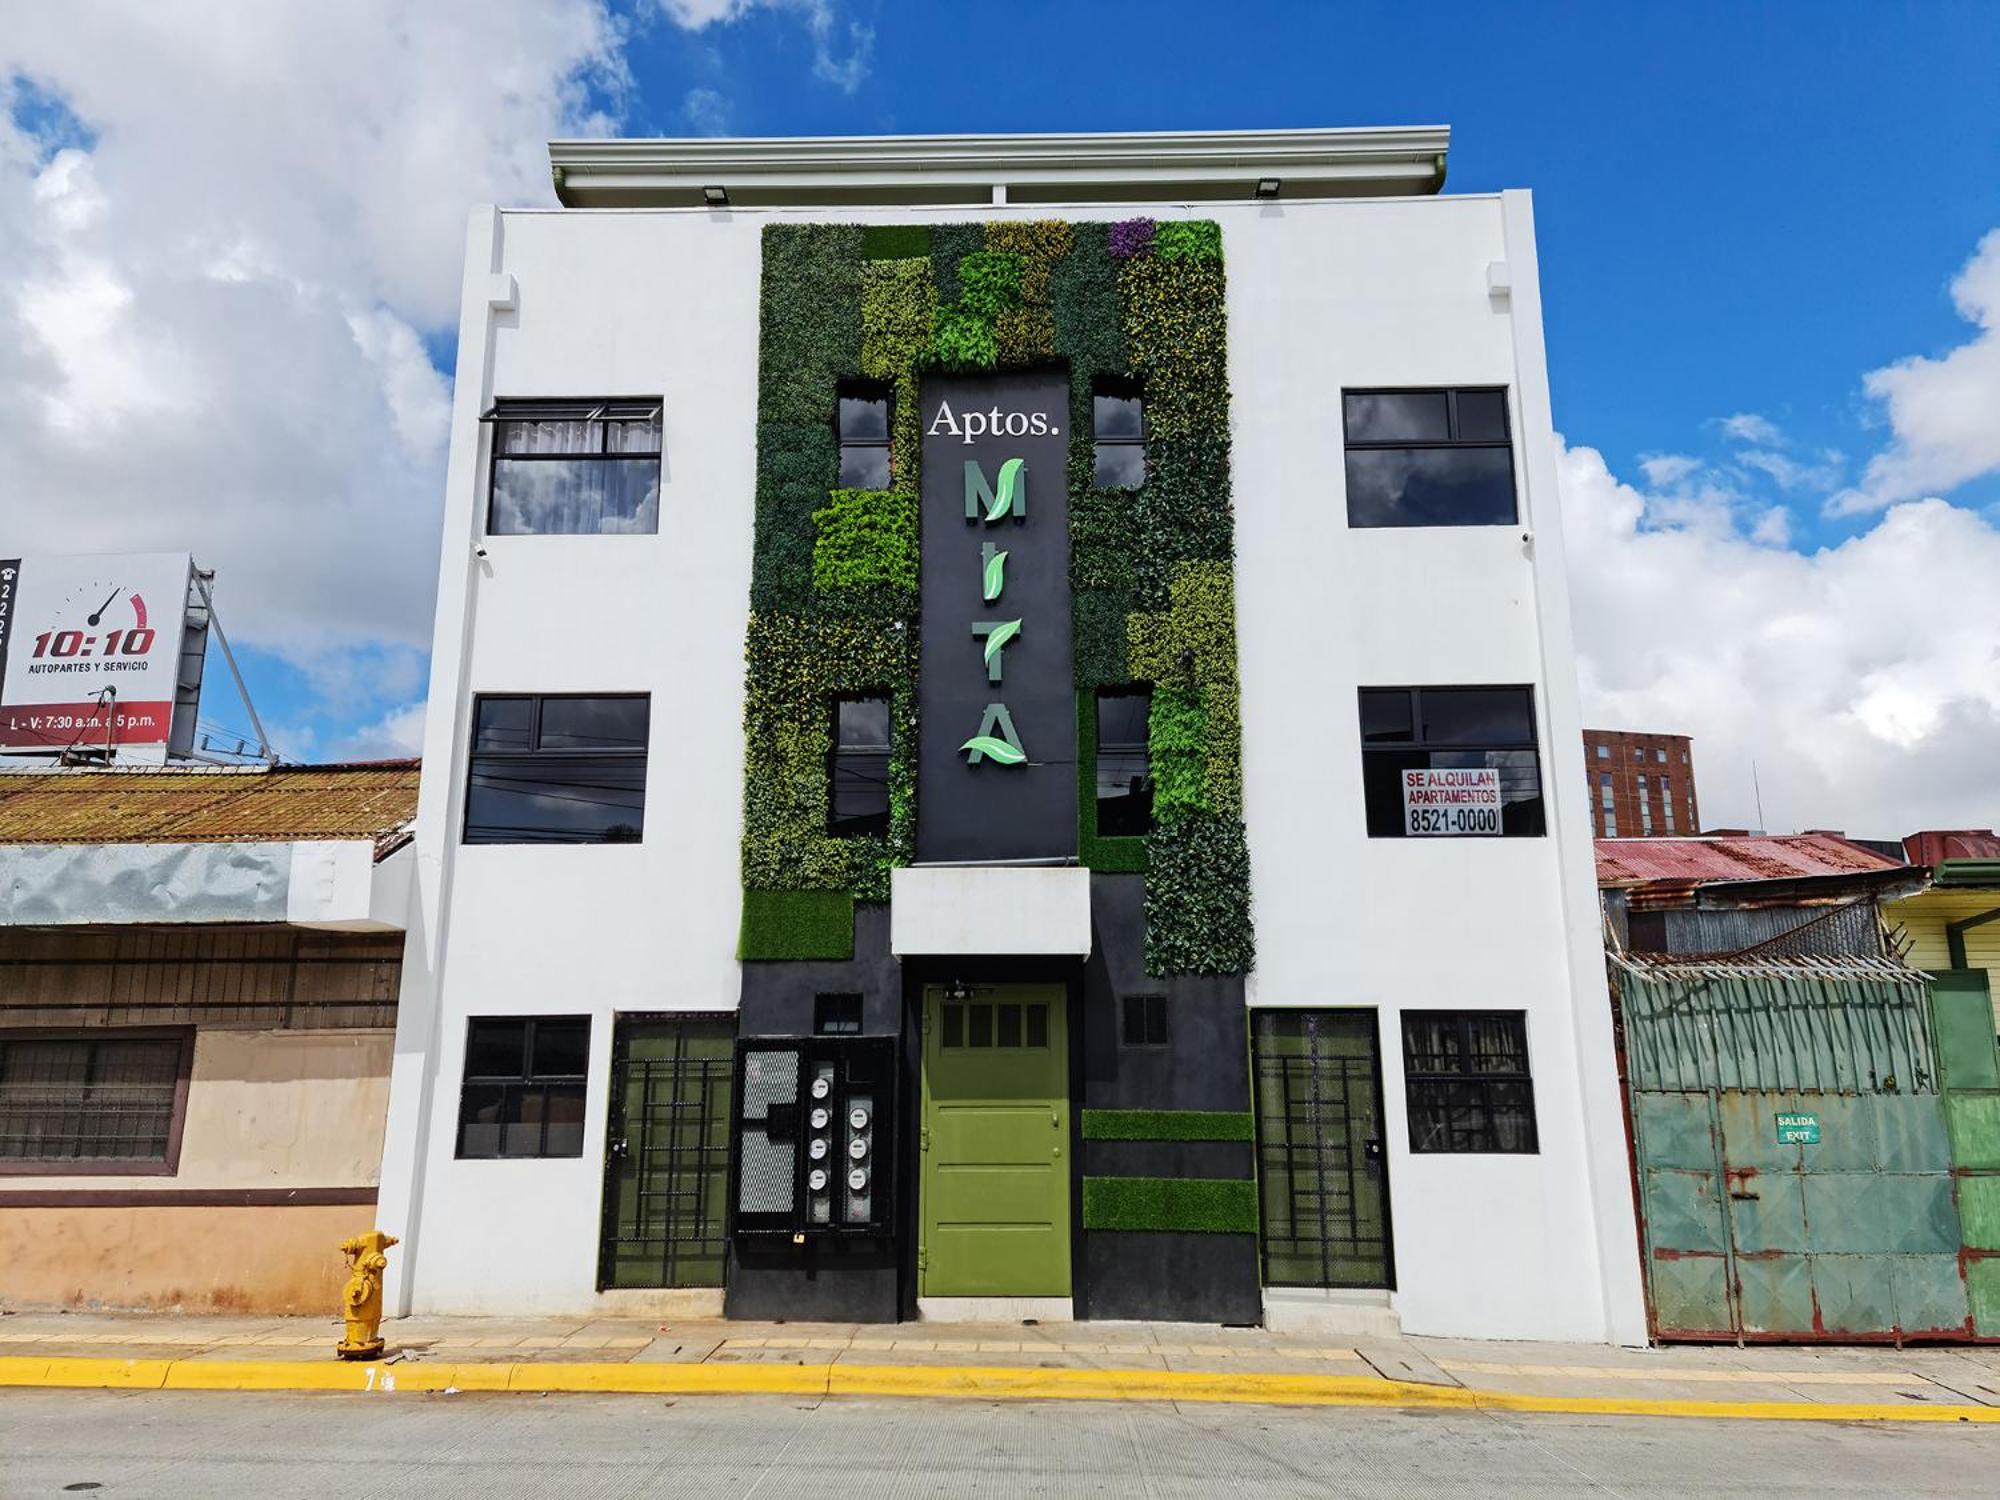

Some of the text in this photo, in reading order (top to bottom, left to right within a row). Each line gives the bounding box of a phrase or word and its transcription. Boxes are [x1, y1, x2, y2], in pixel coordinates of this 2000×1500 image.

[927, 400, 1060, 444] Aptos.
[32, 628, 156, 658] 10:10
[28, 660, 149, 674] AUTOPARTES Y SERVICIO
[10, 718, 18, 730] L
[45, 716, 72, 729] 7:30
[116, 715, 125, 726] 5
[127, 715, 156, 729] p.m.
[1407, 772, 1495, 787] SE ALQUILAN
[1408, 790, 1497, 804] APARTAMENTOS
[1411, 808, 1497, 832] 8521-0000
[1778, 1117, 1815, 1126] SALIDA
[1786, 1131, 1810, 1141] EXIT
